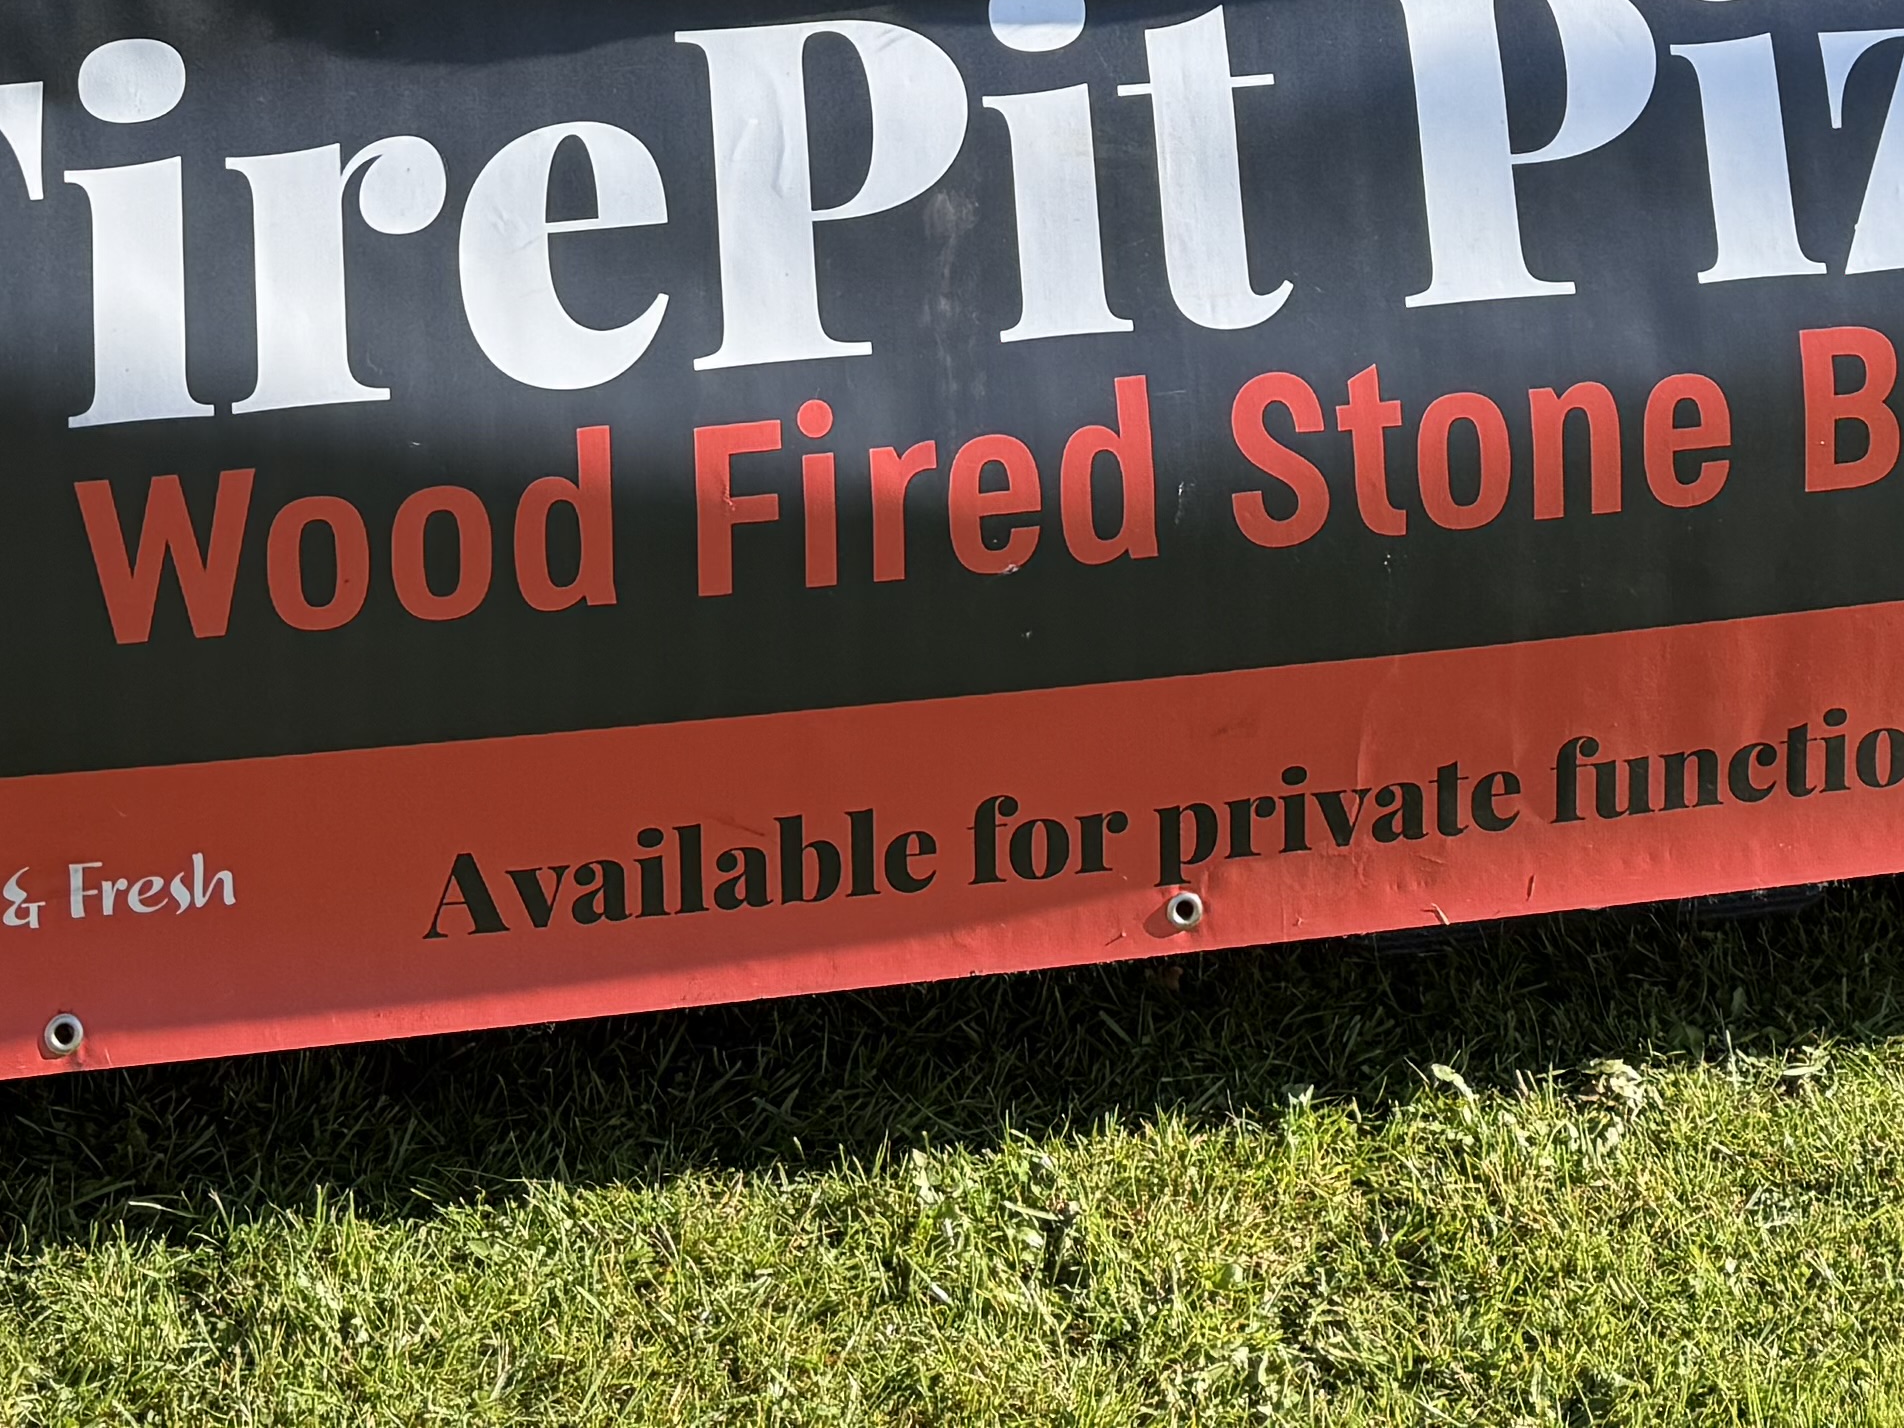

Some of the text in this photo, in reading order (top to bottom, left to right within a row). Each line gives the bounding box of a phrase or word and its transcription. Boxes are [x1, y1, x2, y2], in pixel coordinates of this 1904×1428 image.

[73, 425, 617, 645] Wood
[693, 399, 1157, 597] Fired
[1229, 363, 1730, 548] Stone
[1, 867, 46, 931] &
[68, 852, 236, 924] Fresh
[422, 805, 938, 941] Available
[965, 793, 1129, 887] for
[1154, 763, 1521, 885] private
